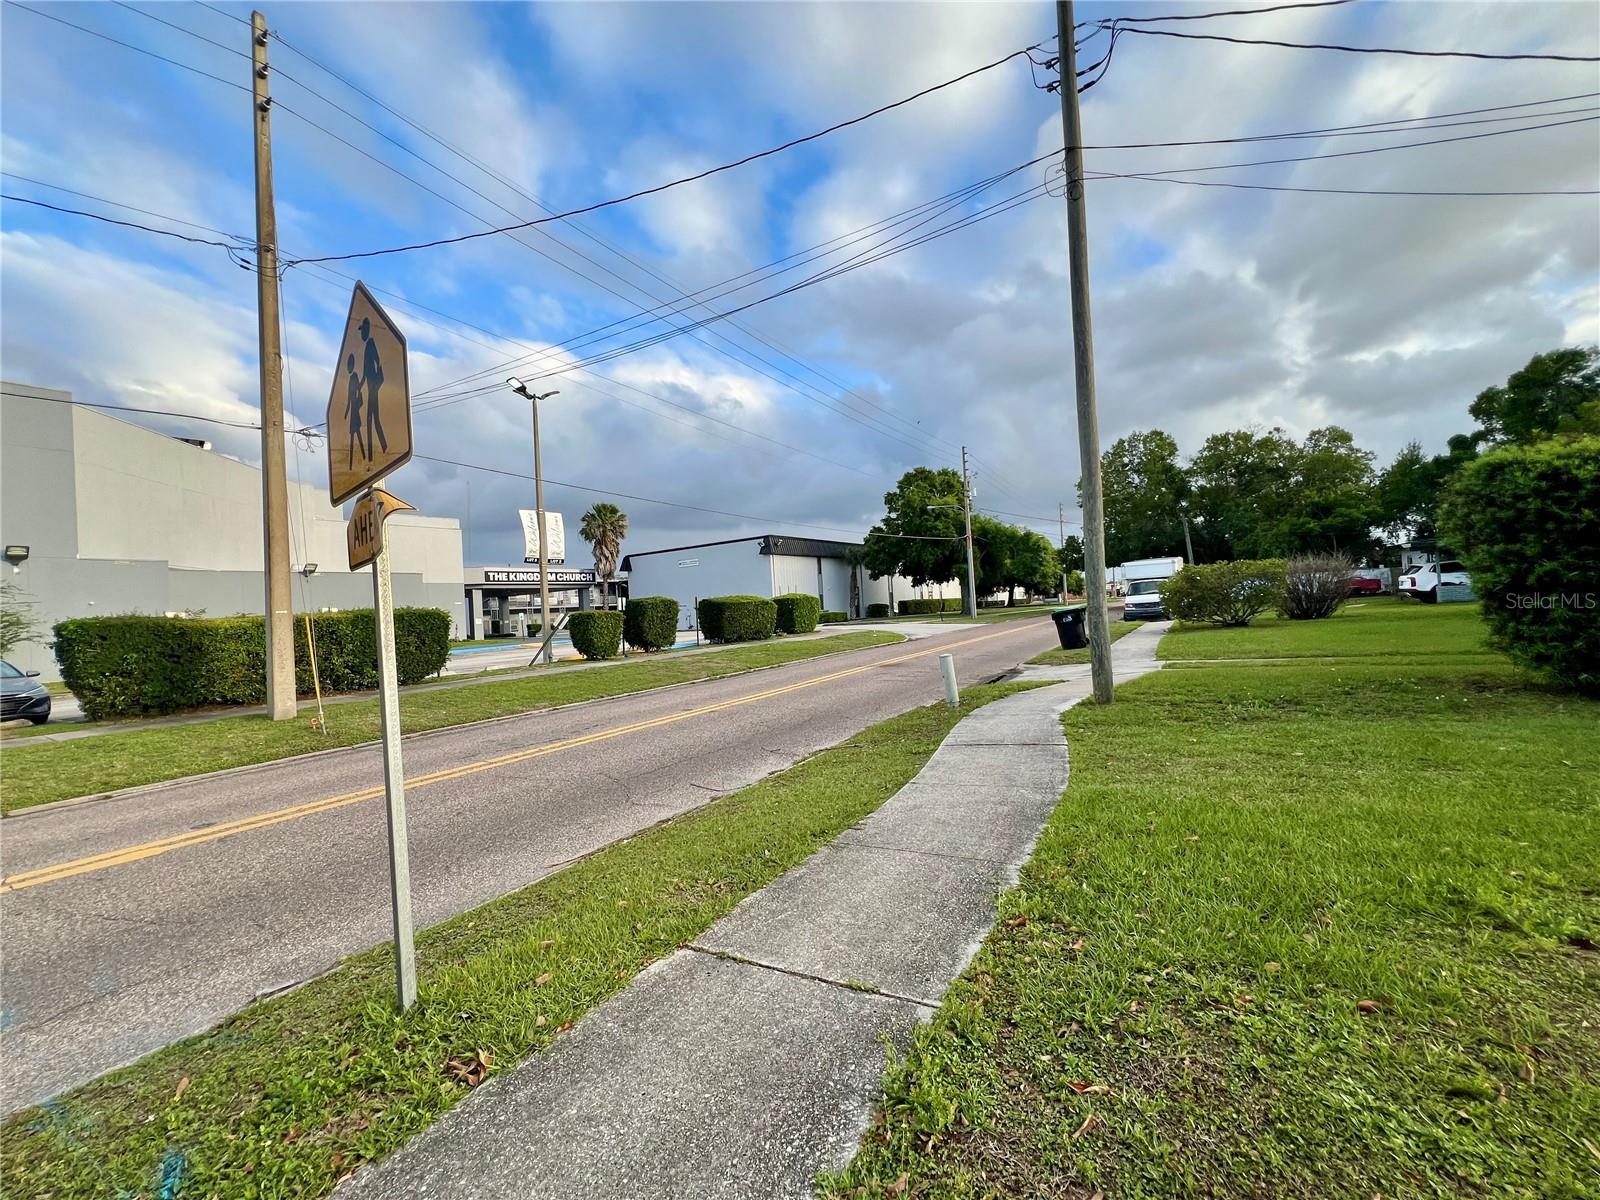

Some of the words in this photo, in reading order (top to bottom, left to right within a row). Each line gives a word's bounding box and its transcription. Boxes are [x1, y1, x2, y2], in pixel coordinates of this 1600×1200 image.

[353, 508, 377, 550] AHE
[488, 572, 508, 581] THE
[509, 572, 556, 581] KINGDM
[557, 573, 593, 581] CHURCH
